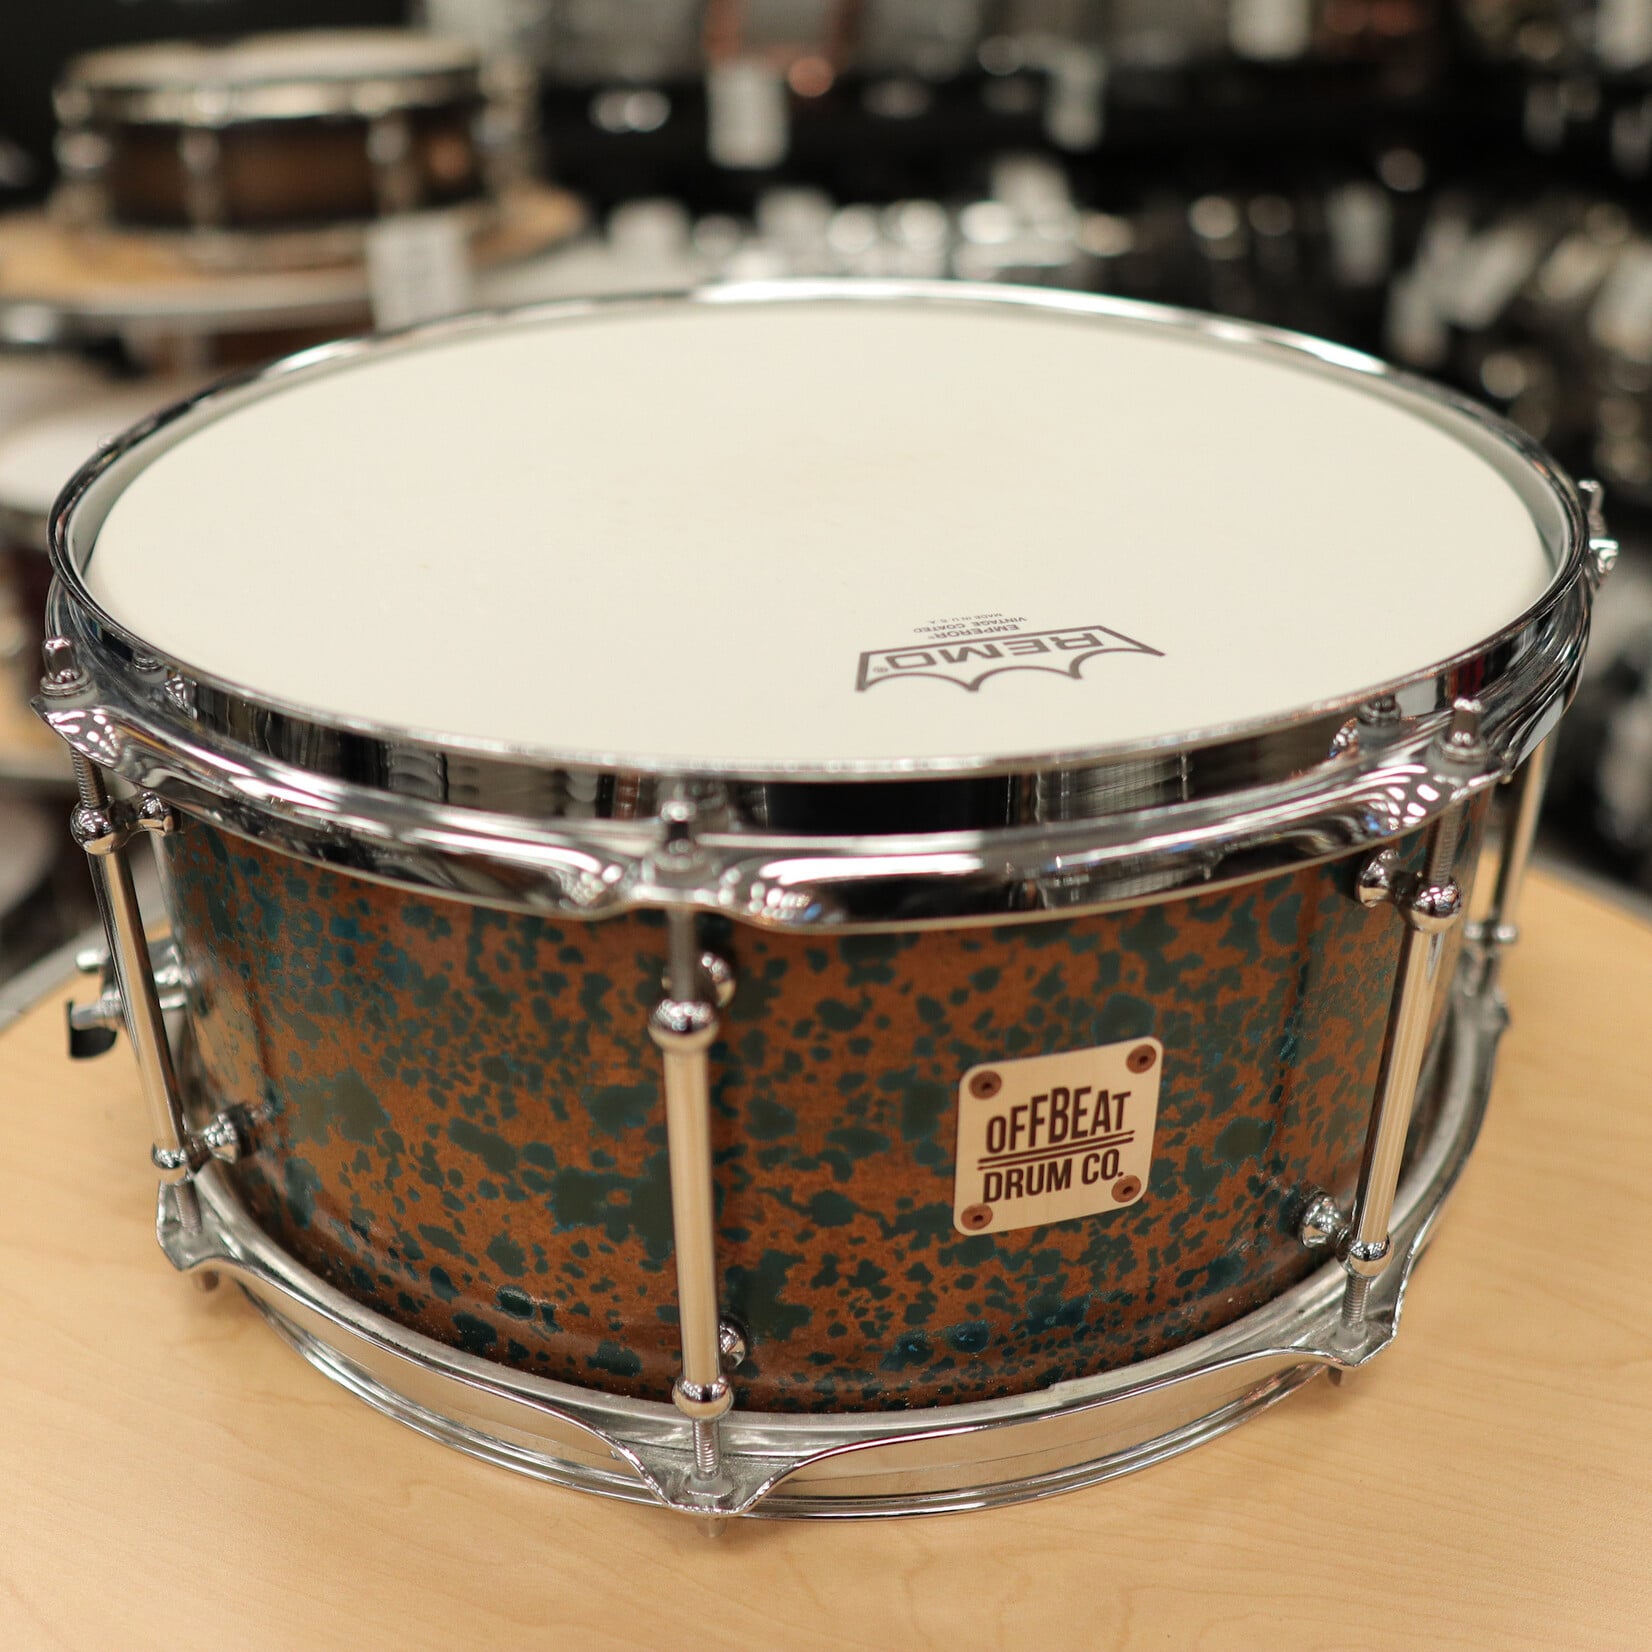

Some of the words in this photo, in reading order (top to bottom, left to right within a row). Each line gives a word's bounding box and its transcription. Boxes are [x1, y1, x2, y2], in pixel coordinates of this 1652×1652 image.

[971, 616, 1027, 627] VINTAGE
[973, 612, 1003, 620] MADE
[913, 623, 966, 633] COATED
[986, 1086, 1132, 1154] OFFBEAT
[982, 1158, 1073, 1204] DRUM
[1081, 1148, 1124, 1185] CO.
